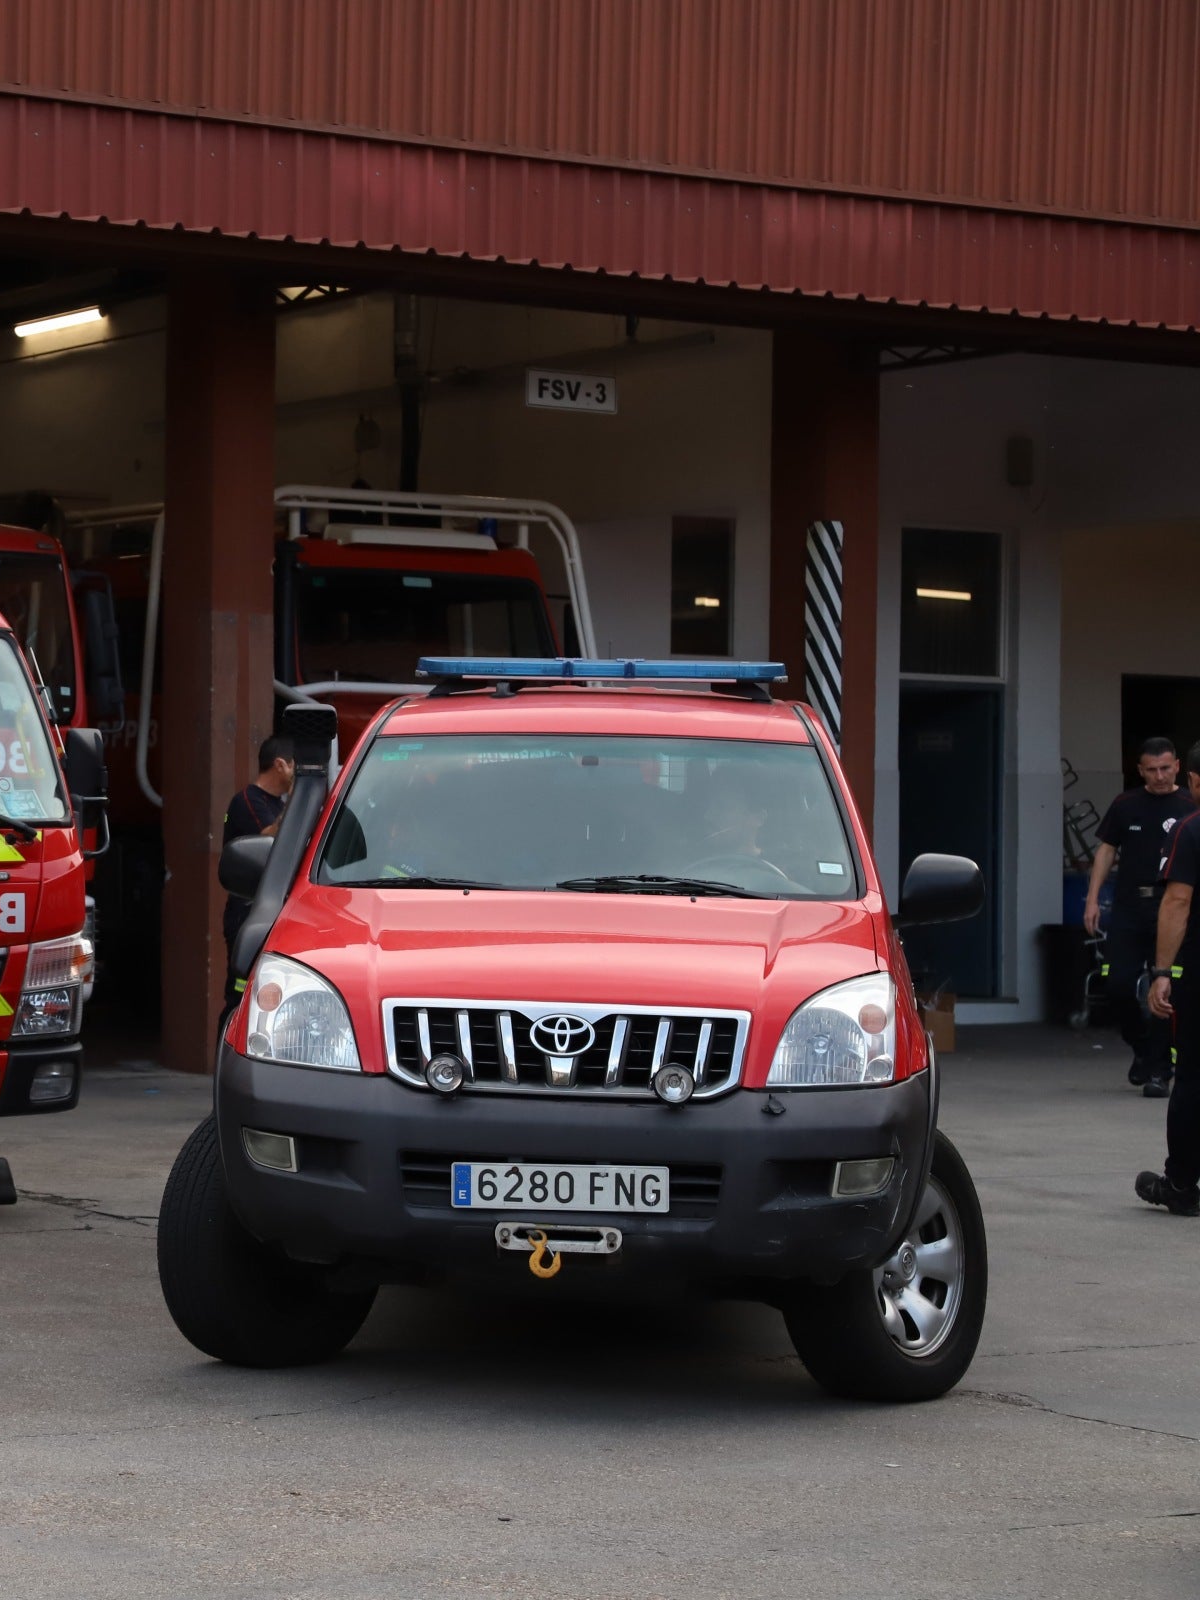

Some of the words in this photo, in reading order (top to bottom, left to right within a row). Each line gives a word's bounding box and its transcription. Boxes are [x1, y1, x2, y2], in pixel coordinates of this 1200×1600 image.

[458, 1190, 467, 1199] E
[478, 1168, 575, 1204] 6280
[589, 1172, 661, 1207] FNG
